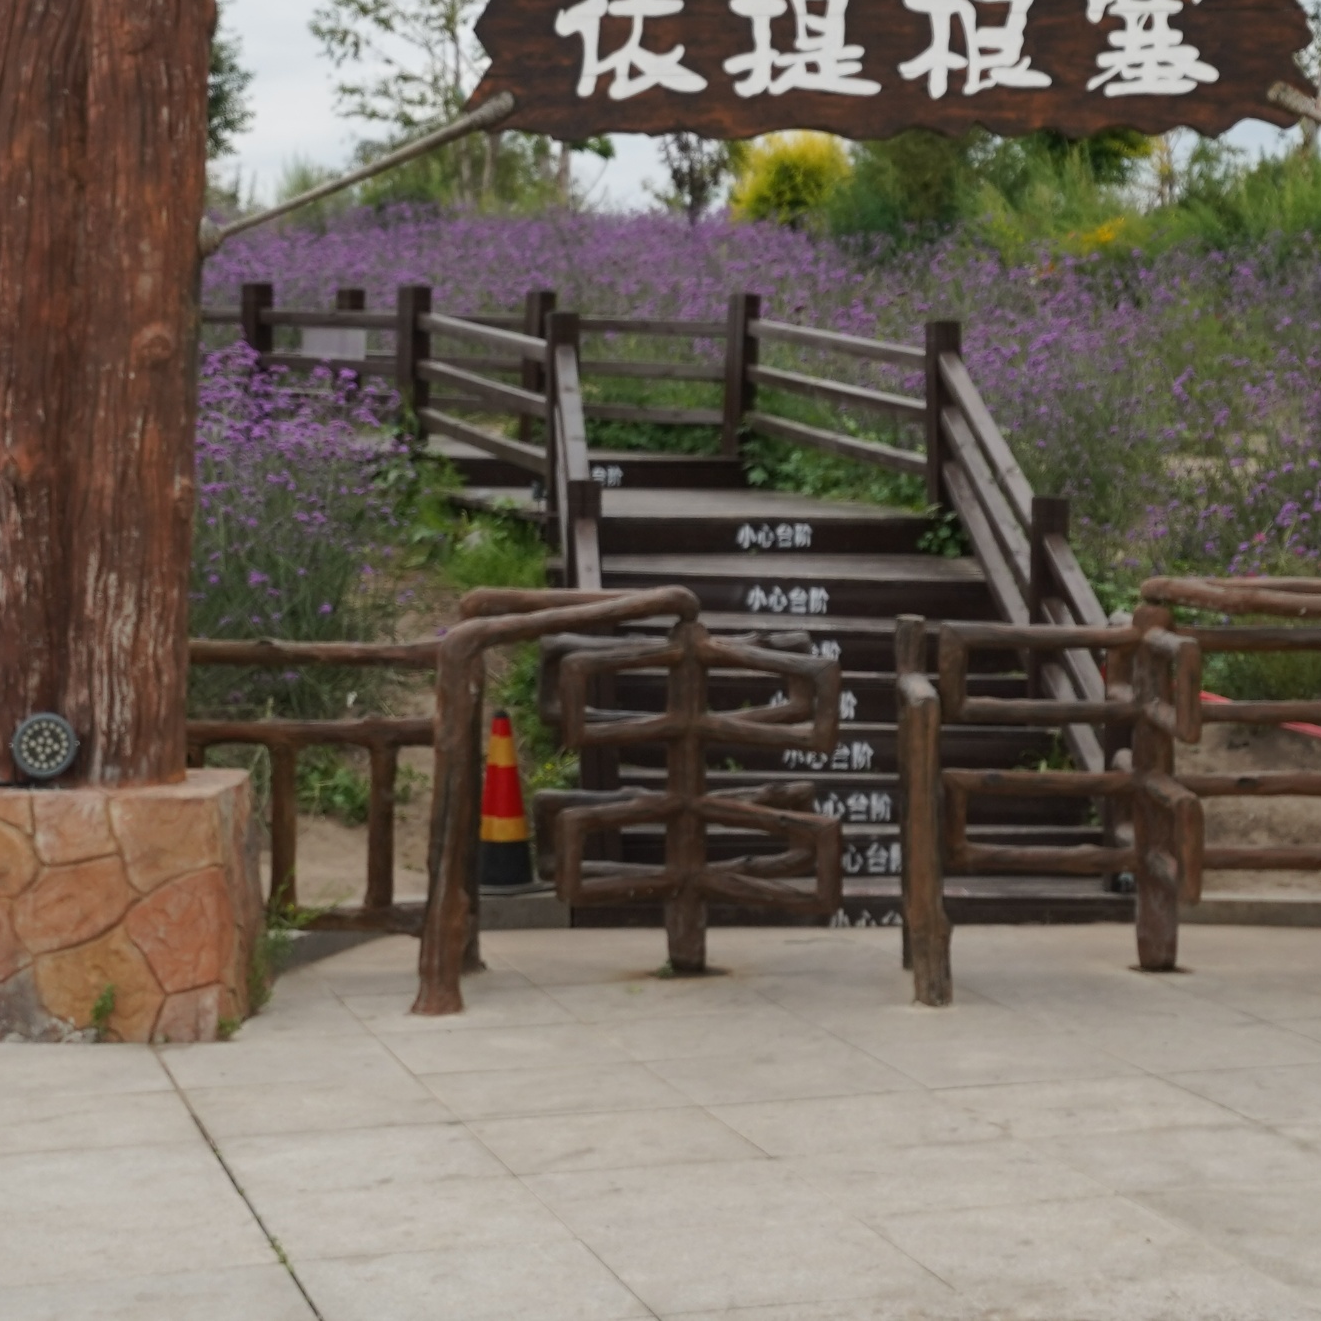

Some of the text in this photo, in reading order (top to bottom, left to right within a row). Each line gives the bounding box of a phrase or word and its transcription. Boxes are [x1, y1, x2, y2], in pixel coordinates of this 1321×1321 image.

[736, 522, 813, 549] 小心台阶
[746, 584, 830, 614] 小心台阶
[813, 792, 892, 821] 心台阶
